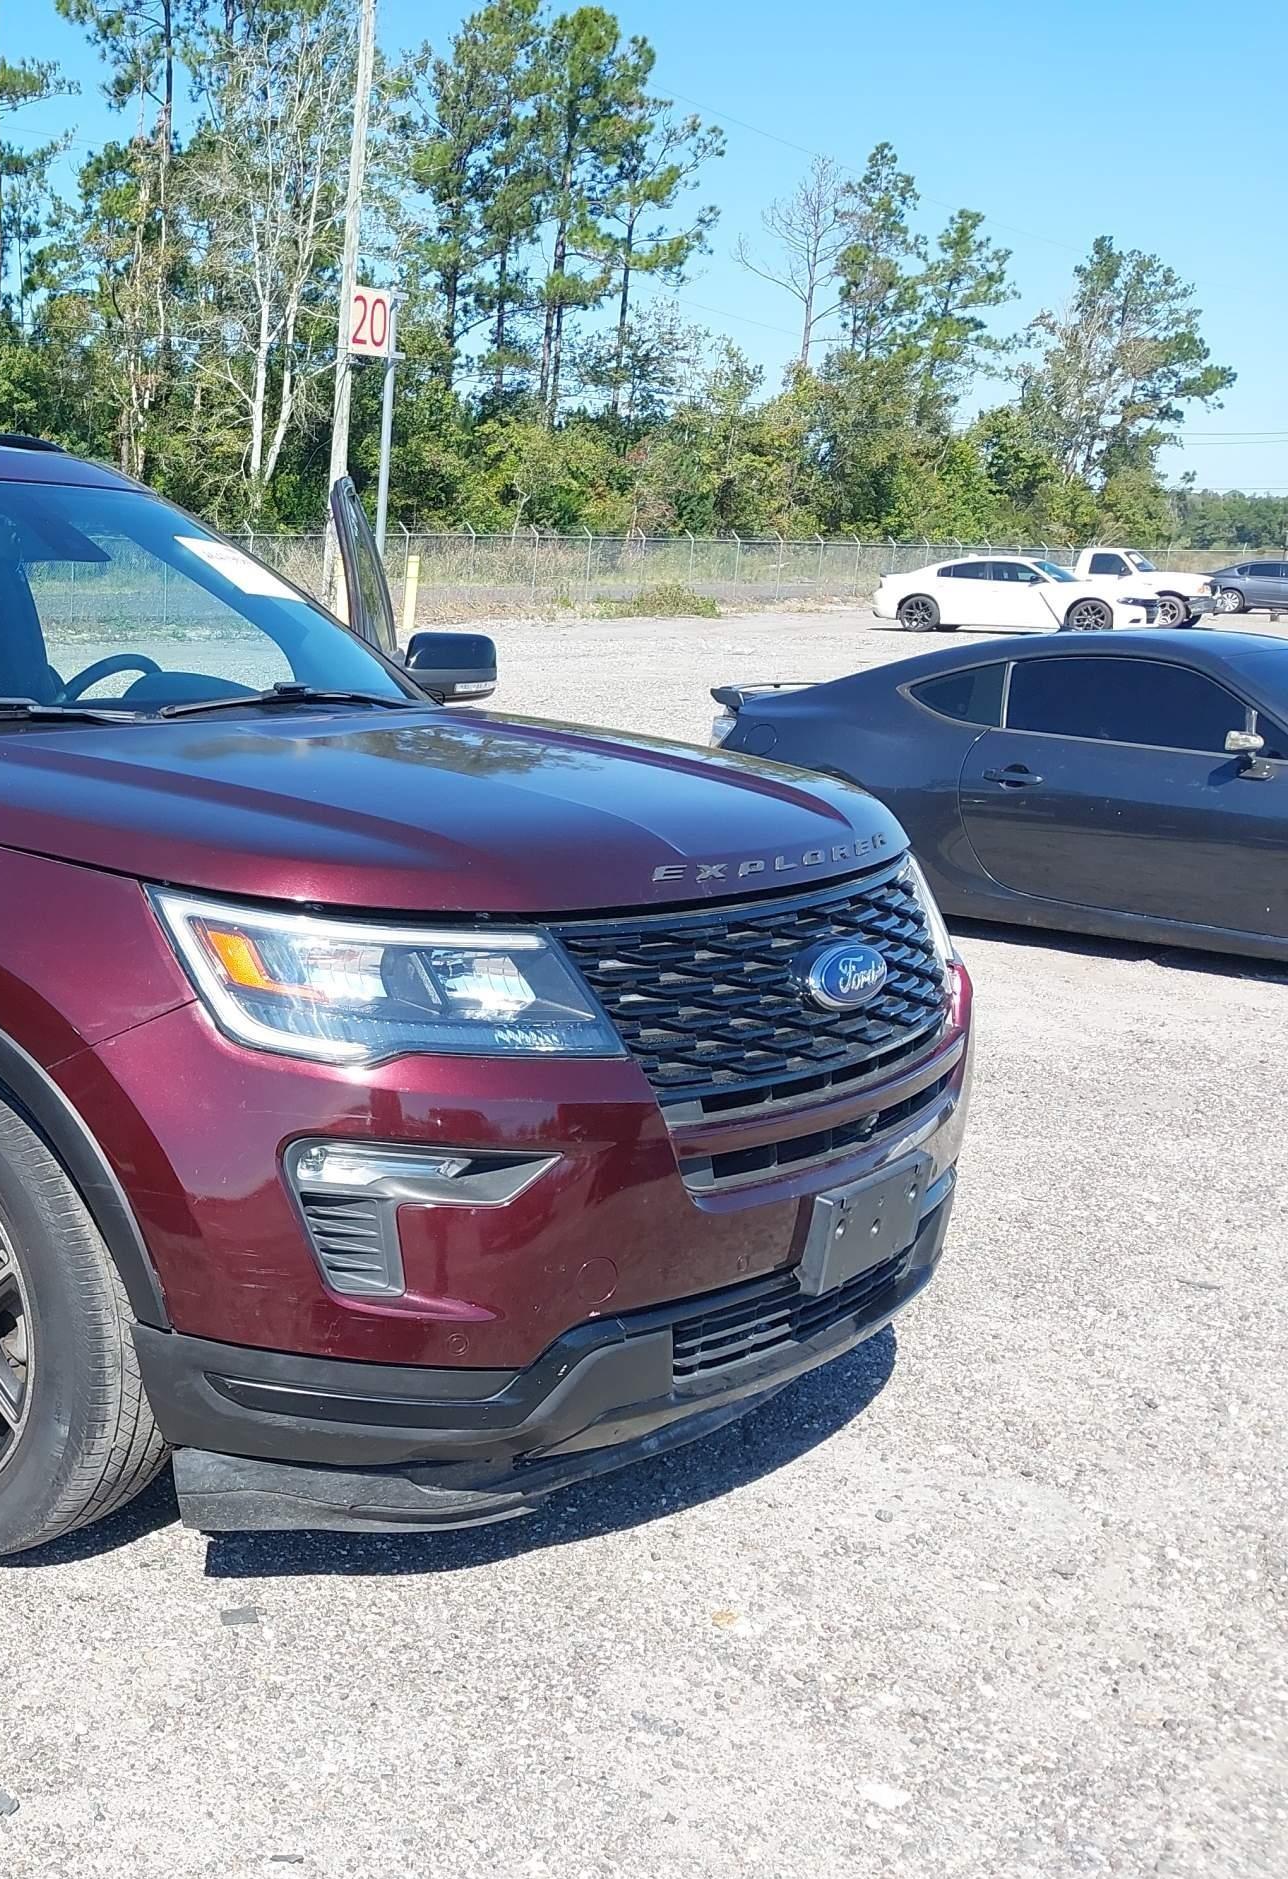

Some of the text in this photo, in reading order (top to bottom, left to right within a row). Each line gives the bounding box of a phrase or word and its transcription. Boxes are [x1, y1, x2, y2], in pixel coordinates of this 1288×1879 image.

[352, 295, 387, 346] 20
[651, 832, 888, 882] EXPLORER
[839, 955, 885, 993] Ford
